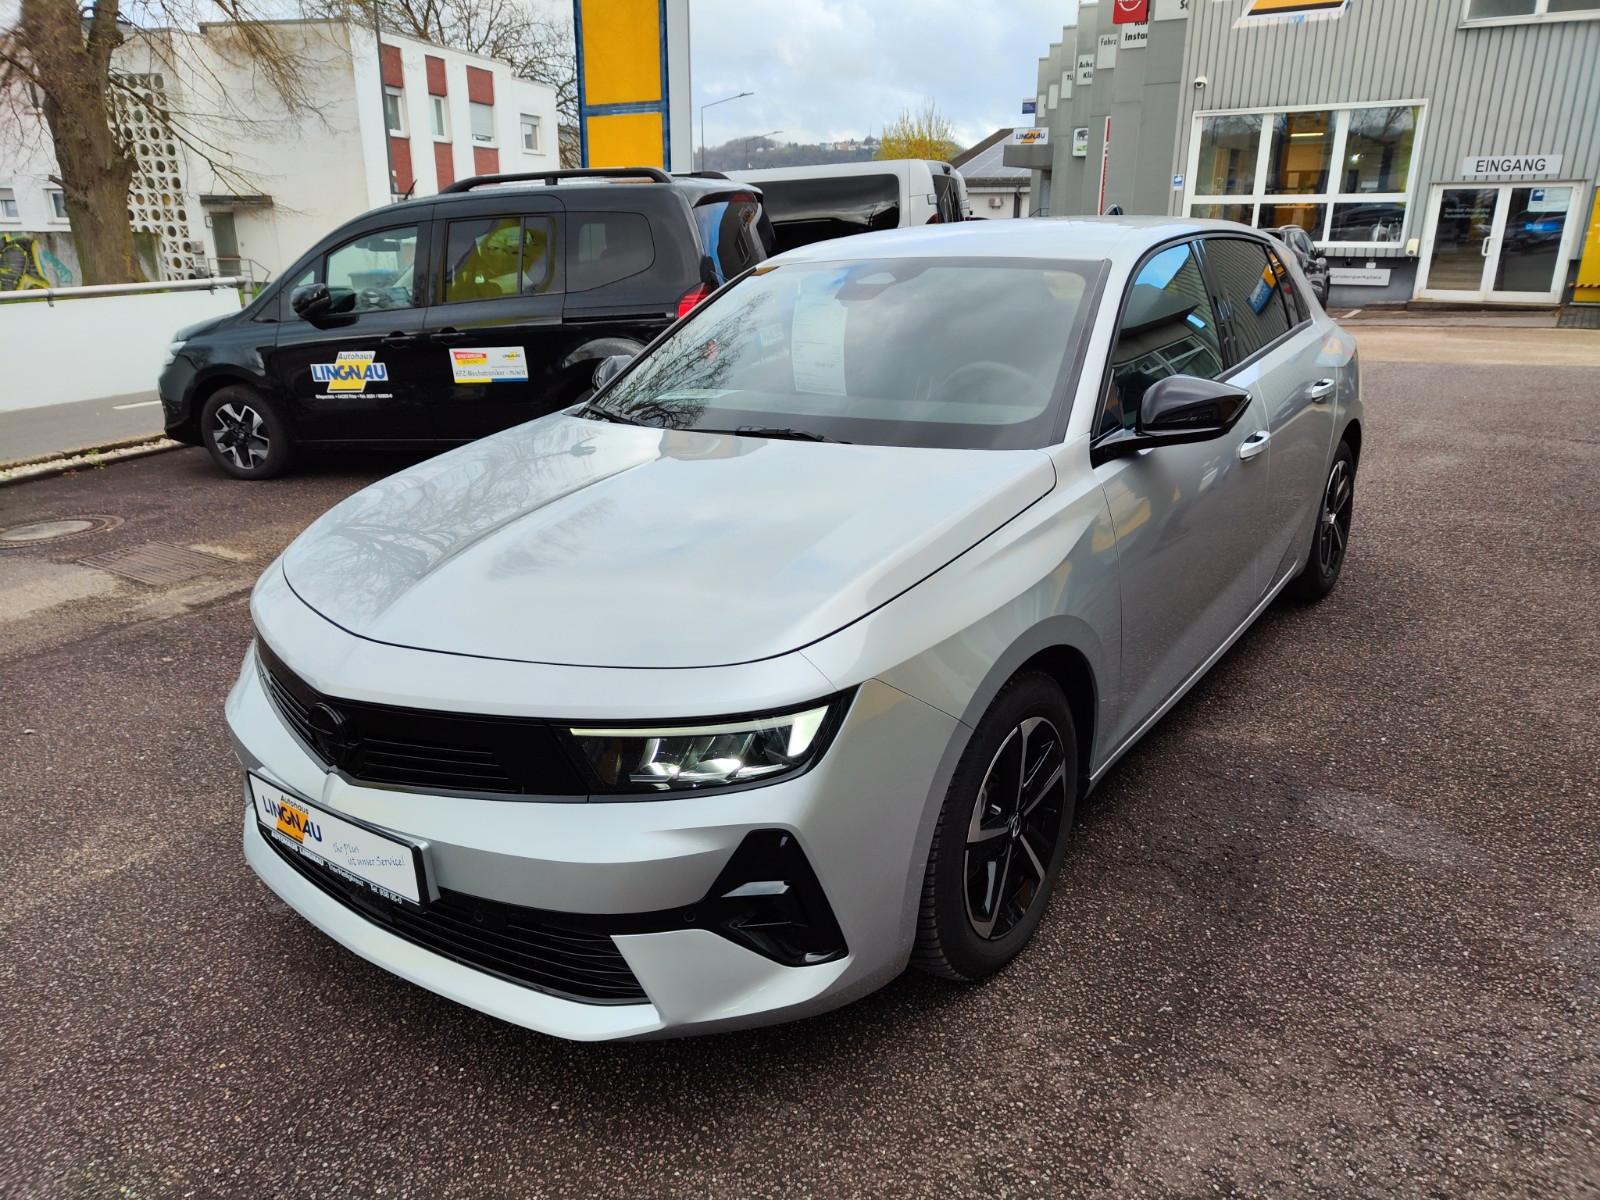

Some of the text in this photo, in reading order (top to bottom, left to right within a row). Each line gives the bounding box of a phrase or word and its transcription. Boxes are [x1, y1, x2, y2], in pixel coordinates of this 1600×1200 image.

[1475, 158, 1547, 173] EINGANG
[339, 352, 373, 361] Autohaus
[312, 364, 386, 381] LINGNAU
[280, 794, 309, 815] Autohaus
[262, 795, 323, 842] LINGNAU
